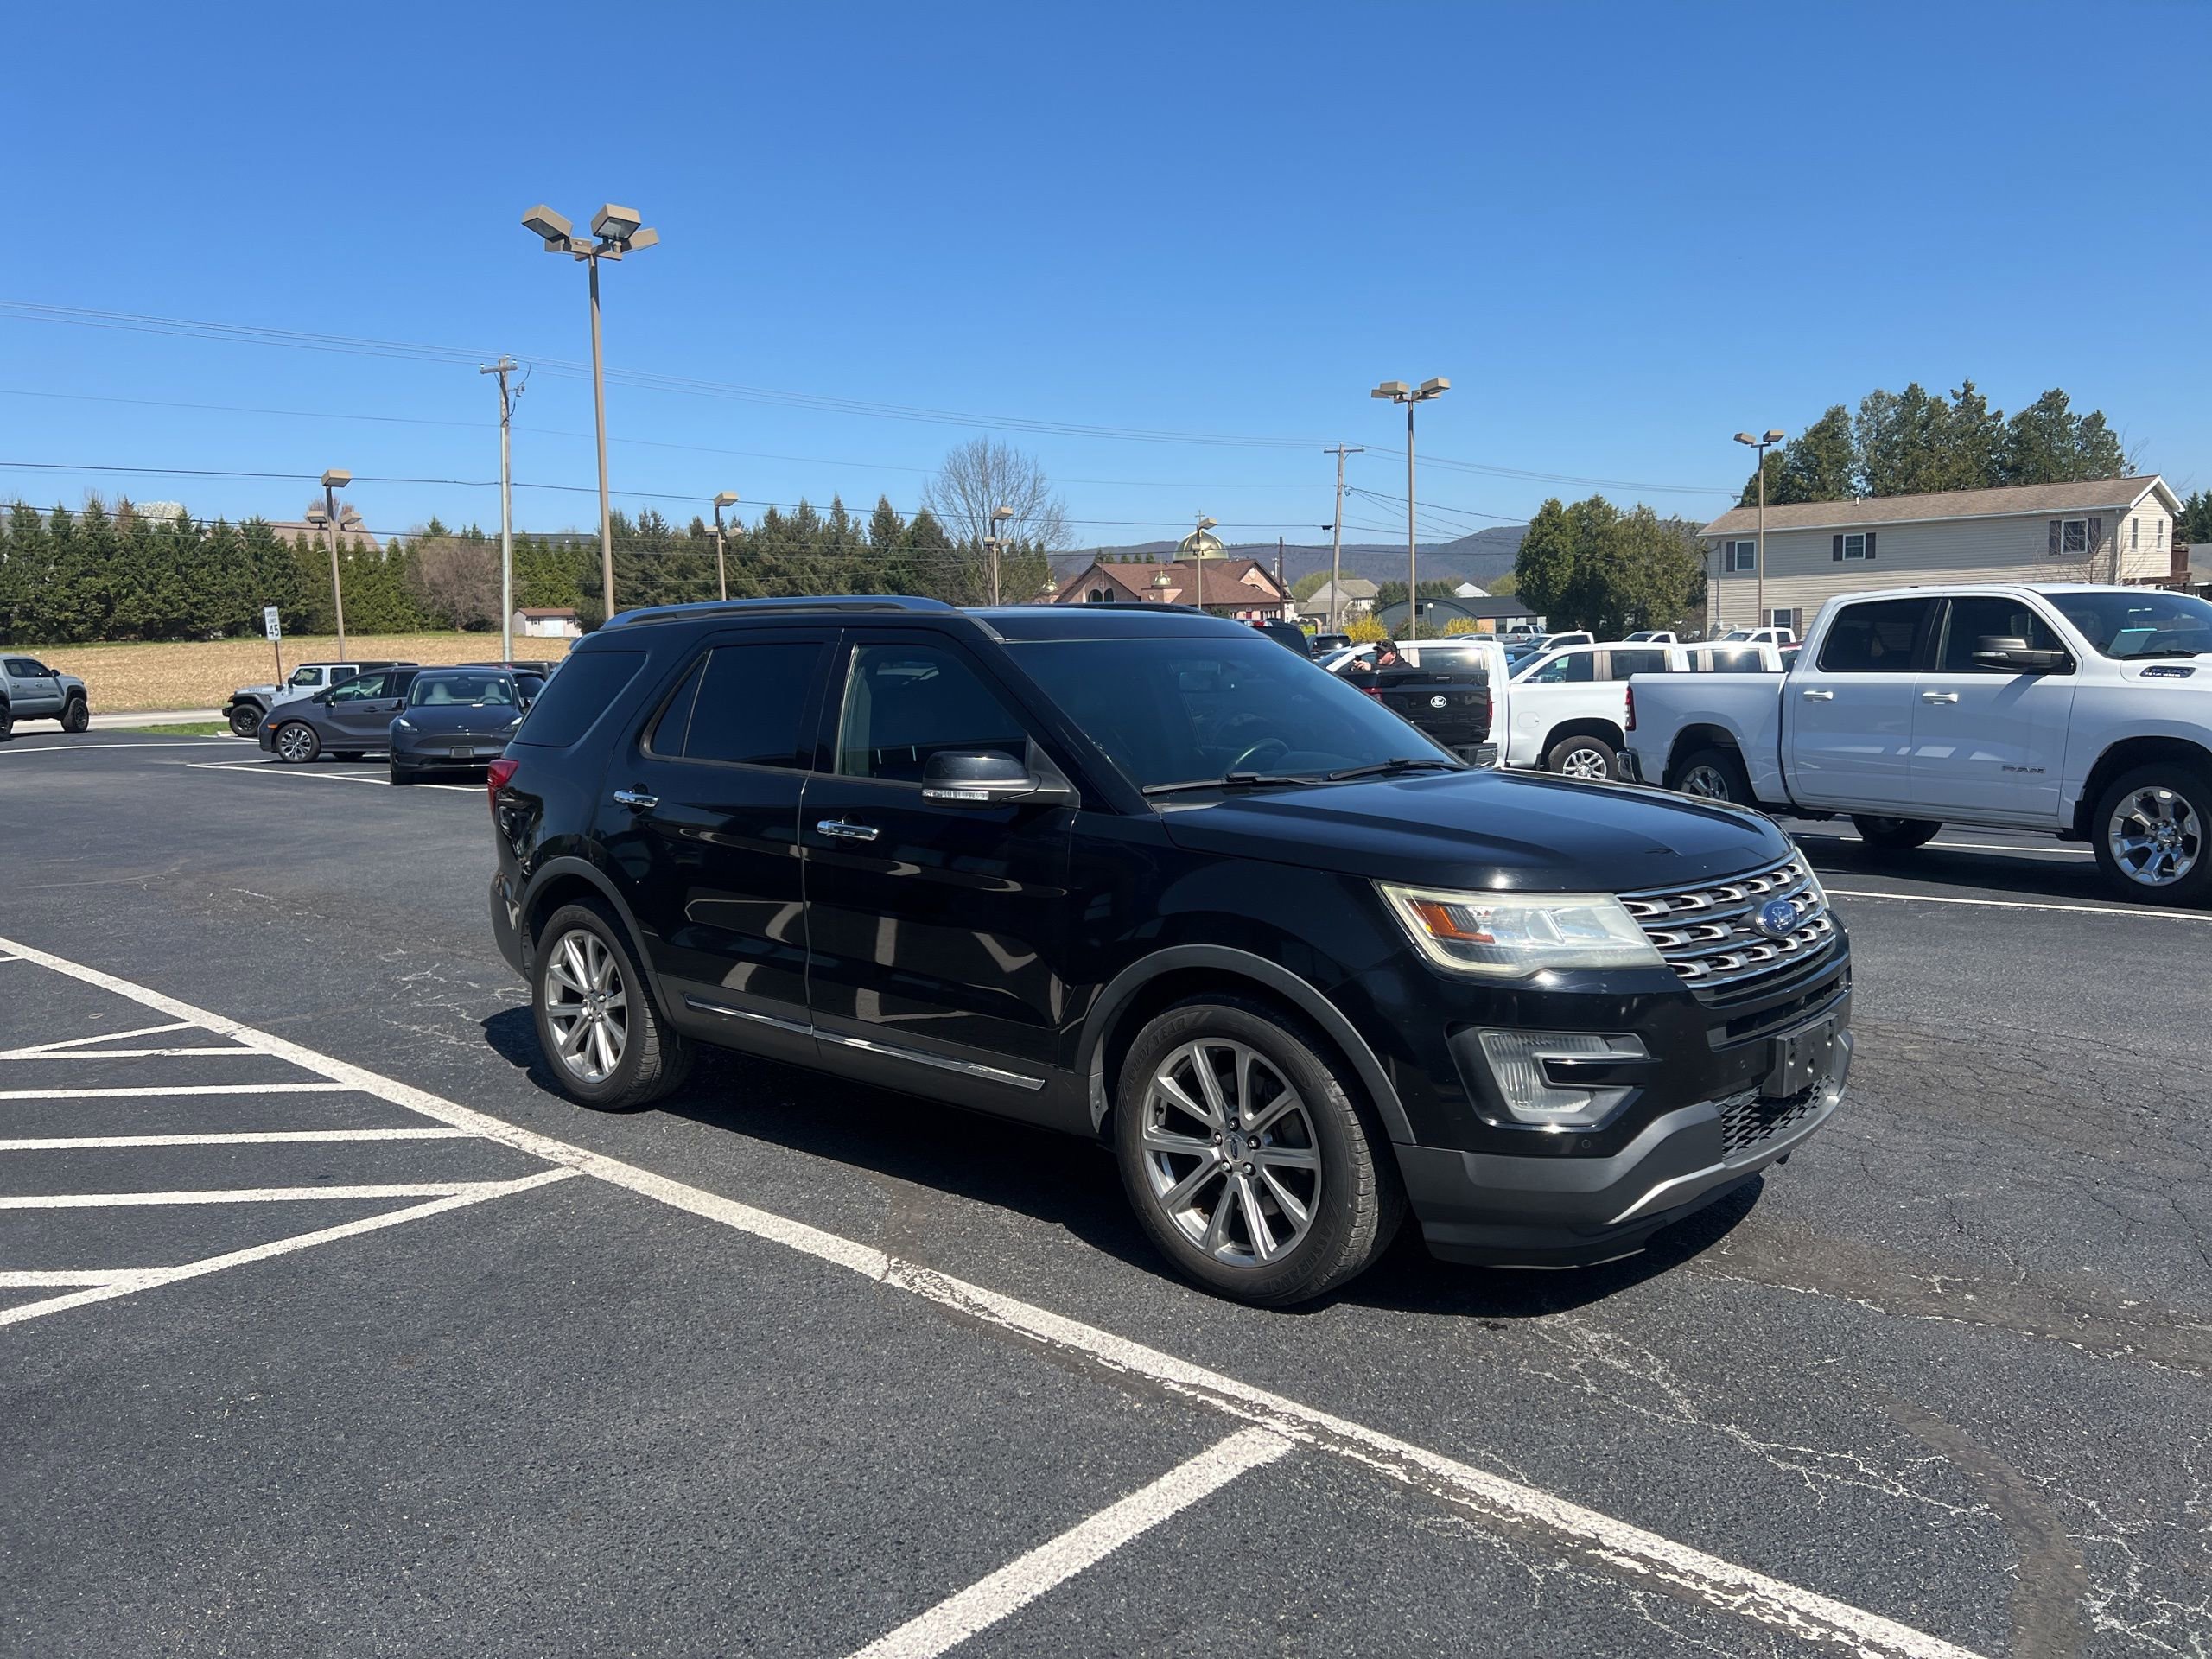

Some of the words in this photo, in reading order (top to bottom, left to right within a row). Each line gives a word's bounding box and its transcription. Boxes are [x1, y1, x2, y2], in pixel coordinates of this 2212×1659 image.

[269, 624, 279, 637] 45
[2002, 766, 2046, 774] RAM
[1771, 905, 1794, 931] Ford
